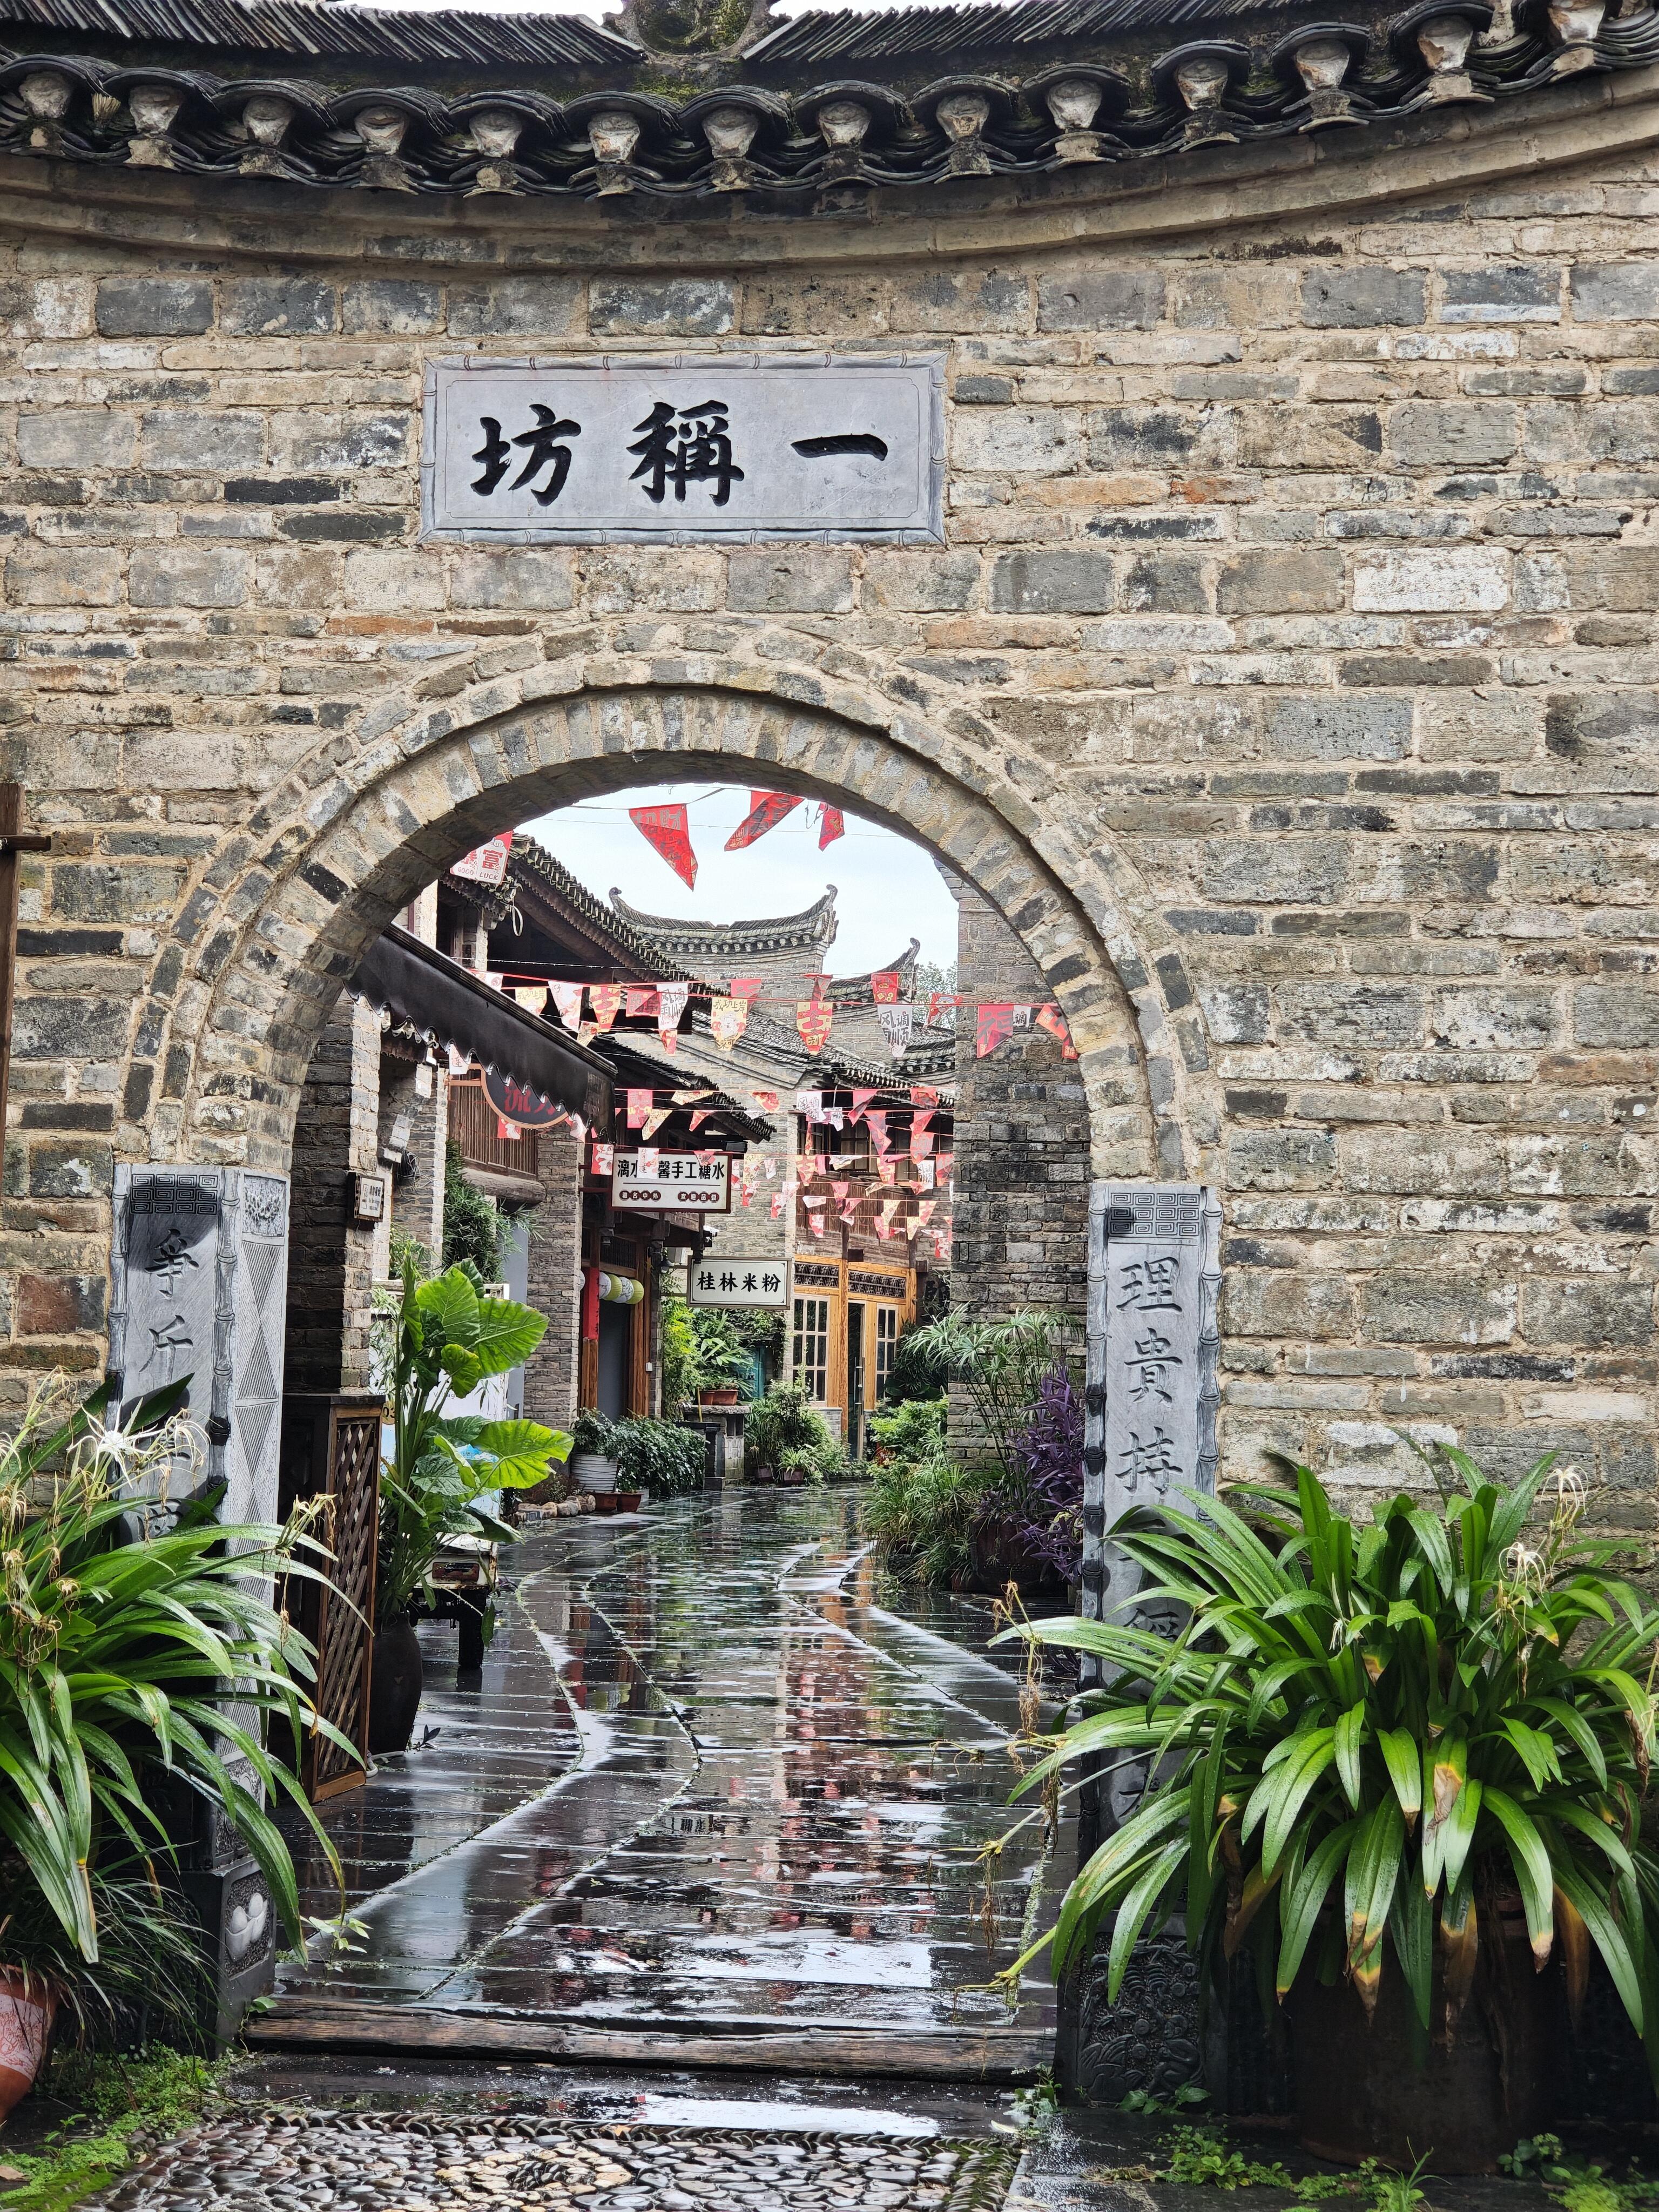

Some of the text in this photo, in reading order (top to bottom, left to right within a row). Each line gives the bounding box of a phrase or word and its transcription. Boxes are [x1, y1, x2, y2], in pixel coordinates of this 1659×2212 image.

[457, 866, 499, 881] GOOD LUCK
[713, 999, 746, 1014] 成功上岸
[1013, 1011, 1027, 1025] 调
[617, 1159, 725, 1180] 漓水馨手工糖水
[696, 1271, 781, 1293] 桂林米粉
